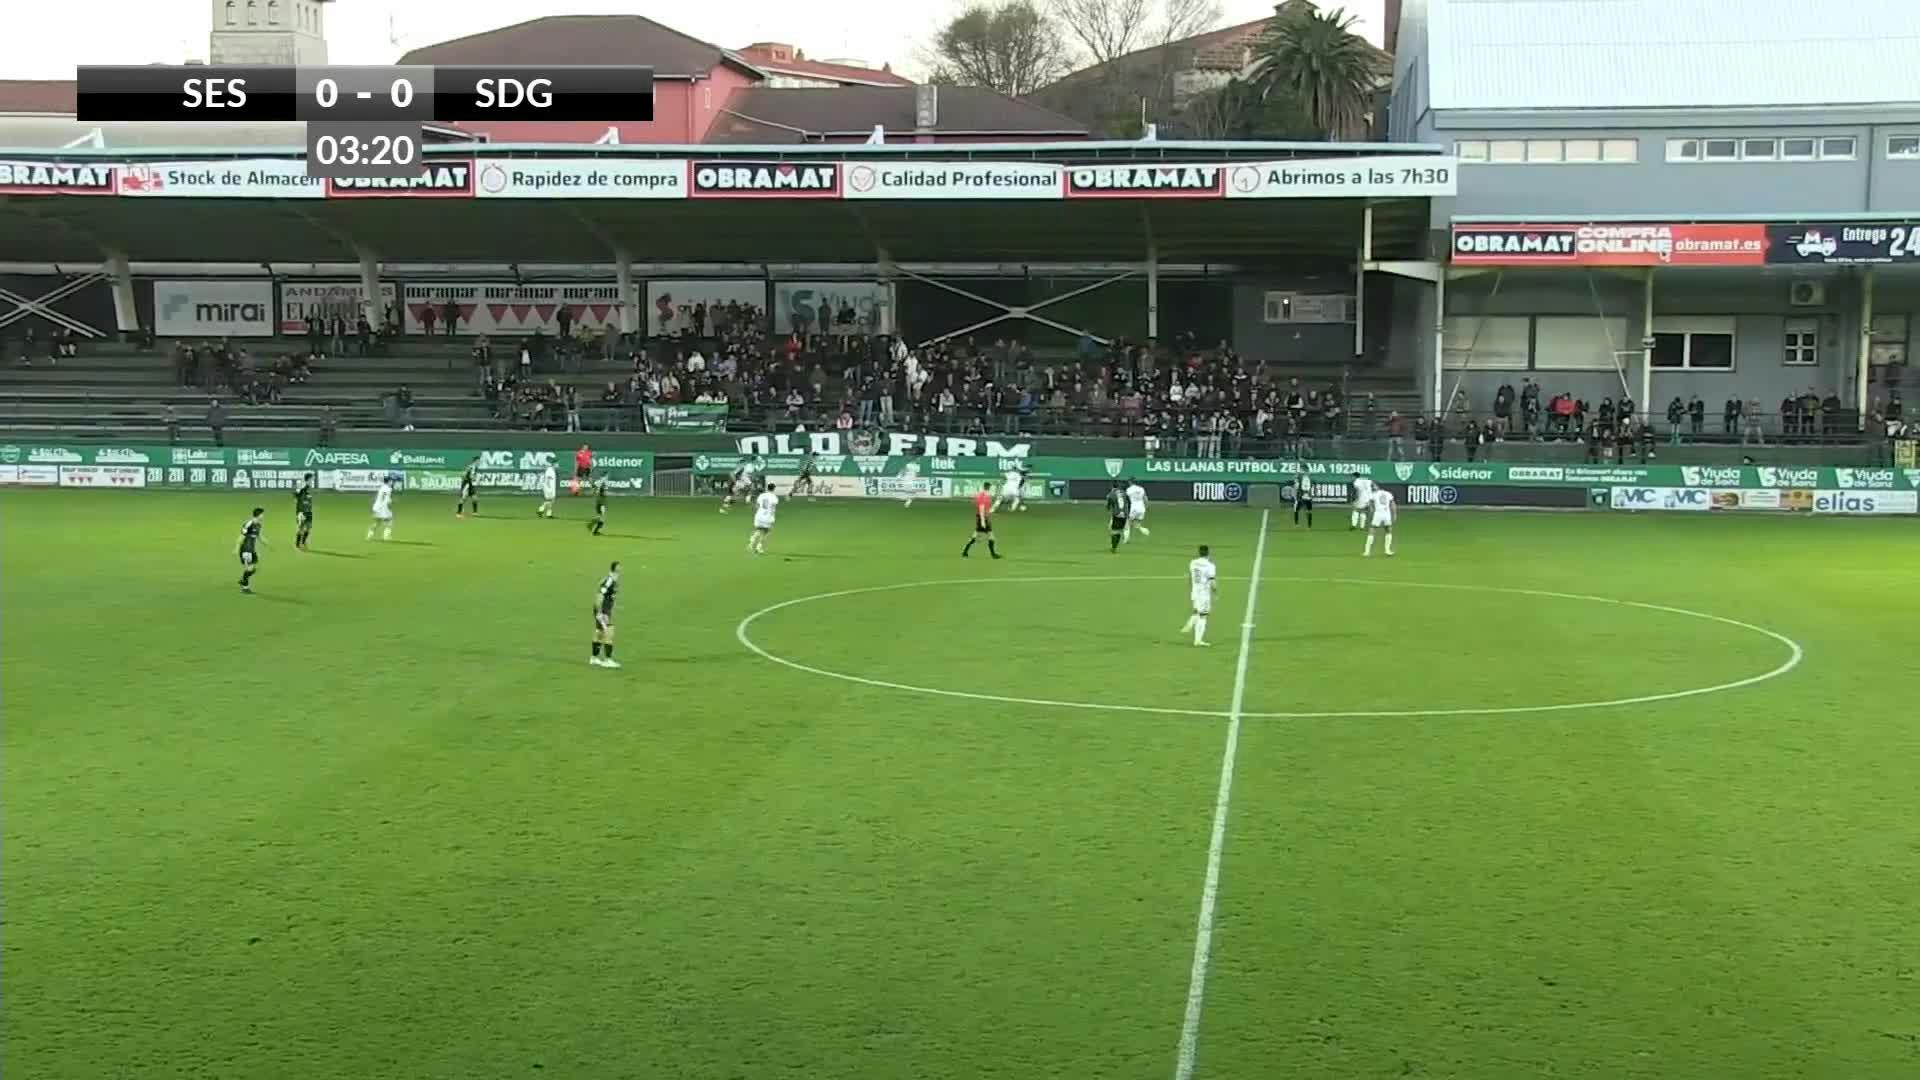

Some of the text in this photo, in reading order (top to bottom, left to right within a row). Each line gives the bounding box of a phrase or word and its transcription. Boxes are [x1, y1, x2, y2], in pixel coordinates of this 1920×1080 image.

[168, 170, 216, 186] Stock
[222, 170, 241, 185] de
[513, 171, 678, 189] Rapidez de compra
[697, 167, 834, 188] OBRAMAT
[882, 170, 1057, 186] Calidad Profesional
[1073, 168, 1216, 188] OBRAMAT
[1268, 168, 1449, 185] Abrimos a las 7h30
[1577, 227, 1671, 239] COMPRA
[1843, 228, 1887, 244] Entrega
[1457, 235, 1573, 252] OBRAMAT
[1577, 239, 1671, 253] ONLINE
[1675, 238, 1761, 251] obramat.es
[285, 287, 393, 297] ANDAMIS
[196, 302, 265, 322] mirai
[740, 432, 1030, 457] OLD FIRM
[325, 453, 369, 464] AFESA
[598, 456, 643, 467] sidenor
[931, 457, 956, 469] itek
[1146, 461, 1171, 472] LAS
[1174, 461, 1224, 473] LLANAS
[1227, 461, 1277, 473] FUTBOL
[1441, 467, 1493, 480] sidenor
[1700, 467, 1741, 480] Viuda
[1777, 468, 1817, 481] Viuda
[1855, 469, 1893, 482] Viuda
